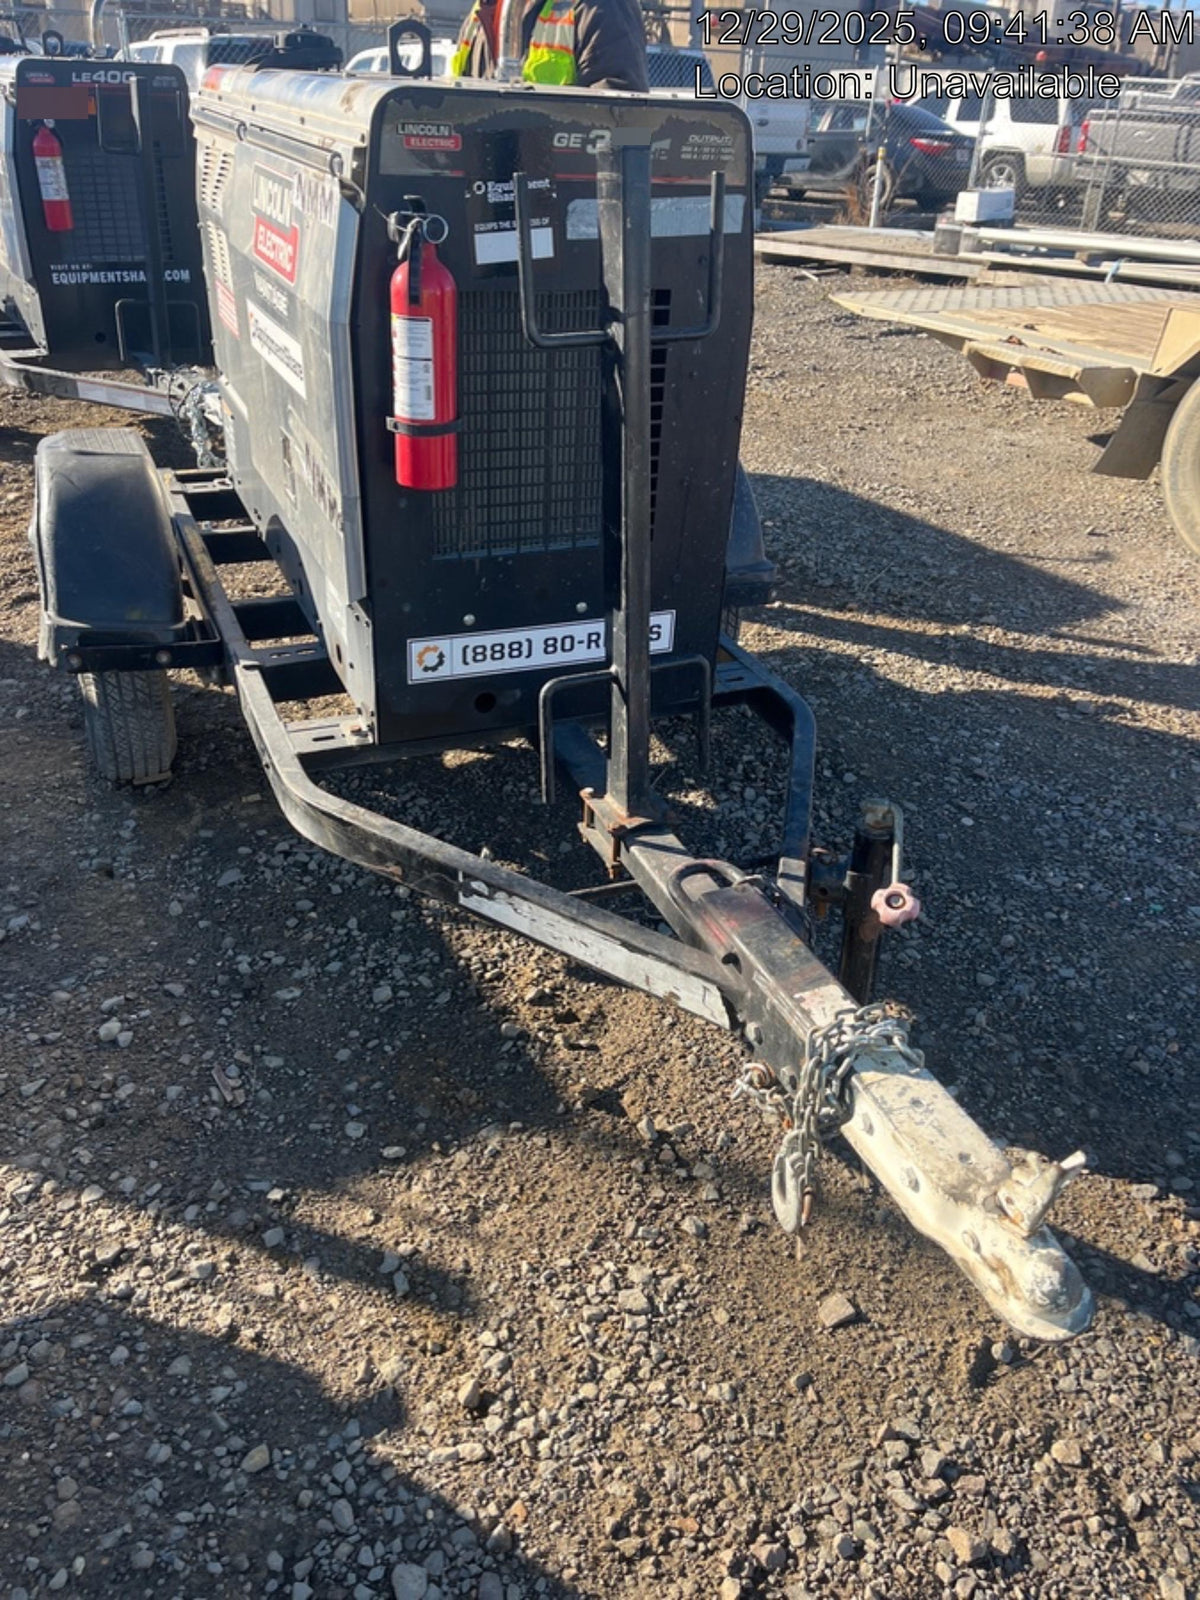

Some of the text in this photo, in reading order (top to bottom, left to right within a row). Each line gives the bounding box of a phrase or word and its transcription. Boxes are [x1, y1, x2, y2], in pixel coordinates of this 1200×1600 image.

[398, 124, 450, 136] LINCOLN
[410, 138, 457, 148] ELECTRIC
[462, 623, 663, 666] (888) 80-RS
